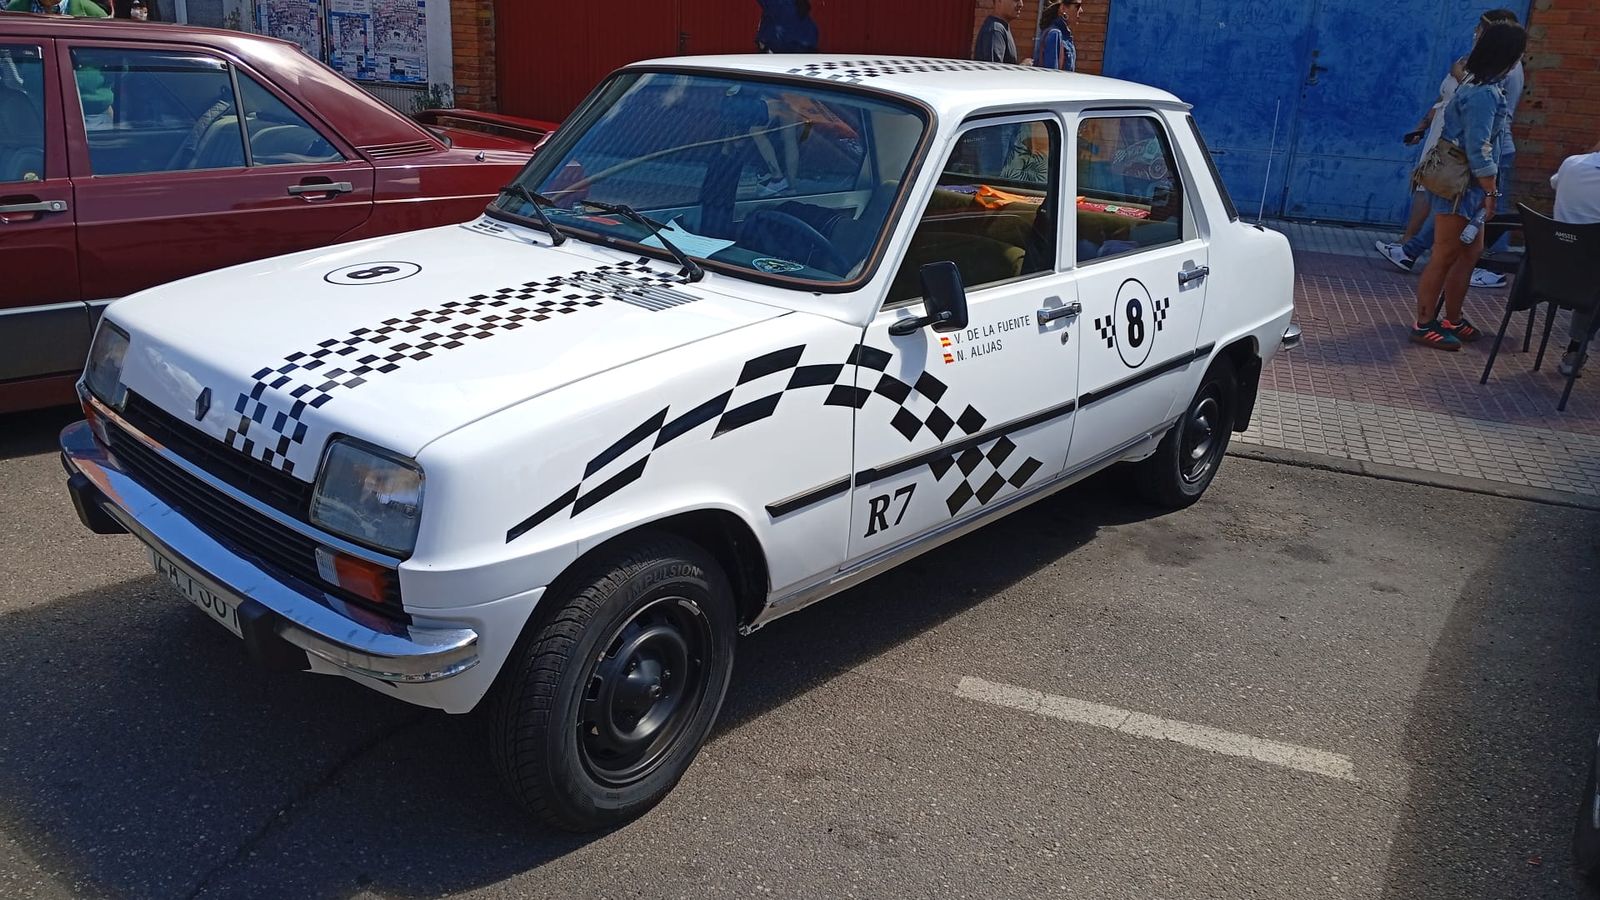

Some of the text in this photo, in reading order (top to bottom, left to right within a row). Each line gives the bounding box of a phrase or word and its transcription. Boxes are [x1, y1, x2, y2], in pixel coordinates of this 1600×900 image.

[346, 266, 400, 279] 8
[954, 315, 1030, 344] V. DE LA FUENTE
[1126, 298, 1144, 348] 8
[957, 339, 1003, 361] N. ALIJAS
[864, 482, 917, 538] R7
